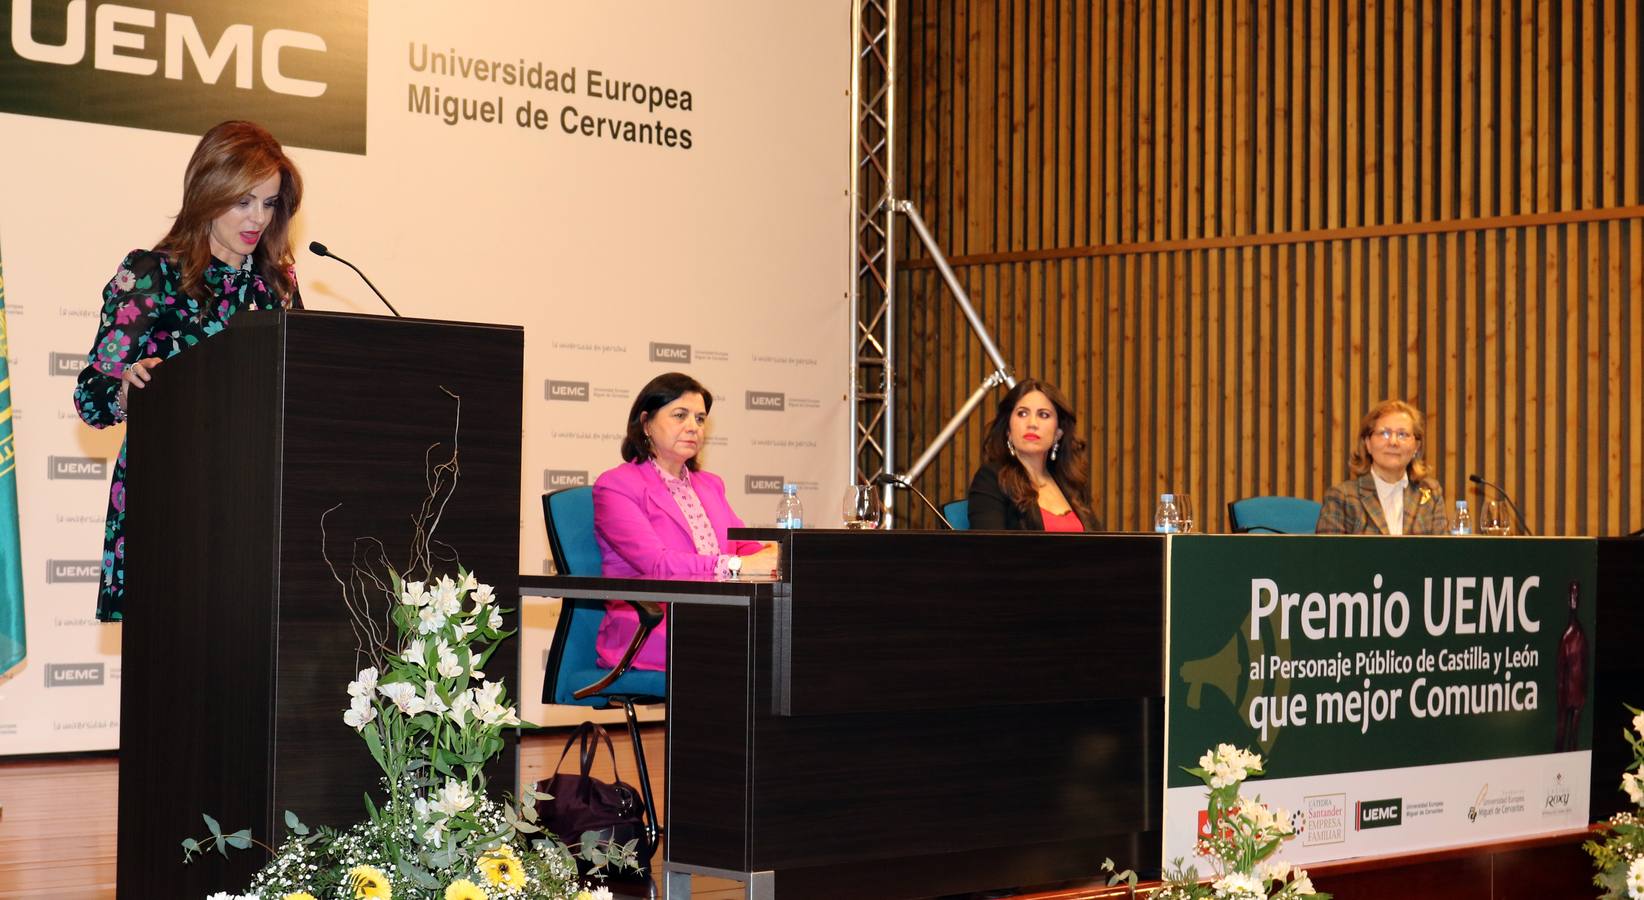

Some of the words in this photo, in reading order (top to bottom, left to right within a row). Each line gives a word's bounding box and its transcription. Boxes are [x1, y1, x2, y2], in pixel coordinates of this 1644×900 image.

[11, 0, 328, 98] UEMC
[409, 41, 576, 94] Universidad
[587, 69, 693, 112] Europea
[408, 84, 503, 126] Miguel
[516, 101, 549, 131] de
[560, 106, 693, 150] Cervantes
[656, 348, 687, 359] UEMC
[552, 385, 585, 396] UEMC
[752, 396, 781, 407] UEMC
[57, 463, 101, 474] UEMC
[551, 475, 585, 485] UEMC
[751, 480, 781, 490] UEMC
[56, 566, 100, 577] UEMC
[1250, 573, 1410, 641] Premio
[1423, 575, 1540, 637] UEMC
[1249, 655, 1265, 680] al
[1270, 652, 1351, 683] Personaje
[1355, 649, 1412, 676] Público
[1416, 651, 1435, 673] de
[1438, 646, 1490, 672] Castilla
[1493, 654, 1502, 676] y
[1505, 644, 1539, 669] León
[54, 669, 99, 680] UEMC
[1248, 693, 1307, 742] que
[1315, 678, 1402, 734] mejor
[1410, 671, 1539, 719] Comunica
[1308, 805, 1342, 819] Santander
[1362, 806, 1398, 822] UEMC
[1308, 817, 1342, 830] EMPRESA
[1308, 829, 1342, 842] FAMILIAR
